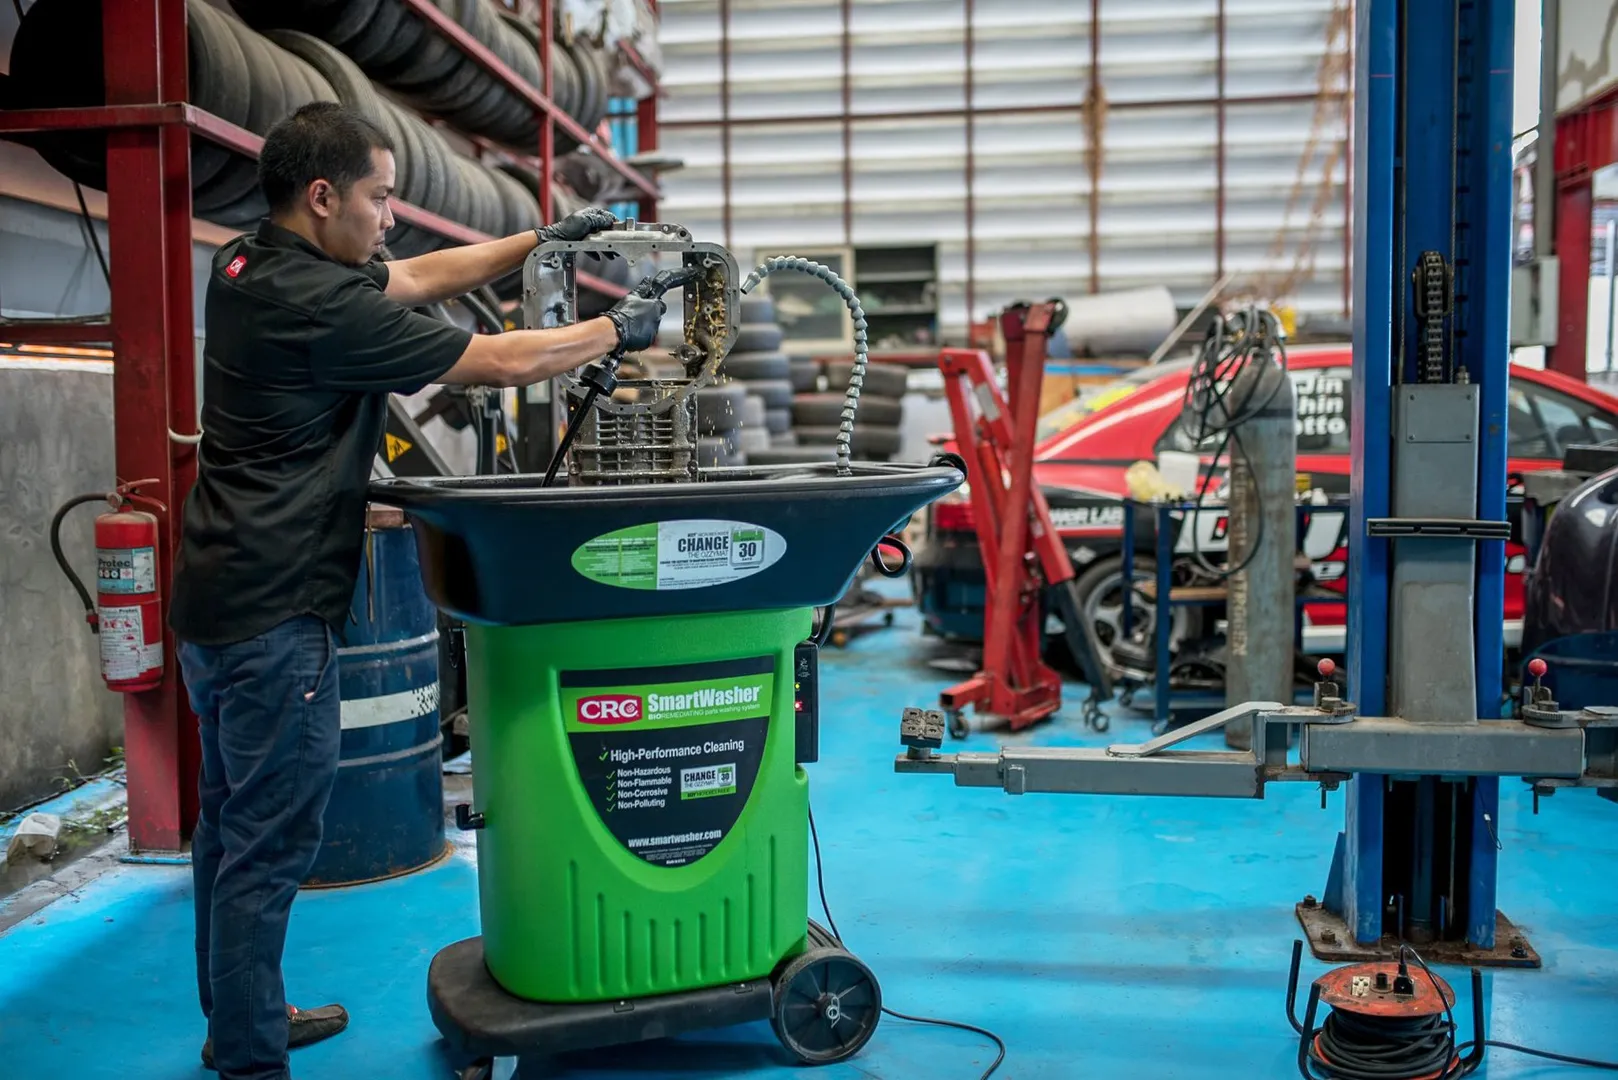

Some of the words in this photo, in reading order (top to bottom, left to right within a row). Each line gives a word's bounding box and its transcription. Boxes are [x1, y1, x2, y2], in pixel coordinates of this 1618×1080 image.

[1297, 394, 1344, 414] hin
[678, 536, 728, 552] CHANGE
[739, 542, 756, 558] 30
[647, 685, 761, 712] SmartWasher
[580, 699, 638, 719] CRC
[648, 709, 704, 720] BIOREMEDIATING
[610, 745, 701, 763] High-Performance
[704, 740, 744, 754] Cleaning
[617, 766, 671, 778] Non-Hazardous
[684, 770, 716, 782] CHANGE
[617, 776, 672, 788] Non-Flammable
[617, 788, 668, 799] Non-Corrosive
[617, 799, 665, 810] Non-Polluting
[628, 829, 722, 847] www.smartwasher.com
